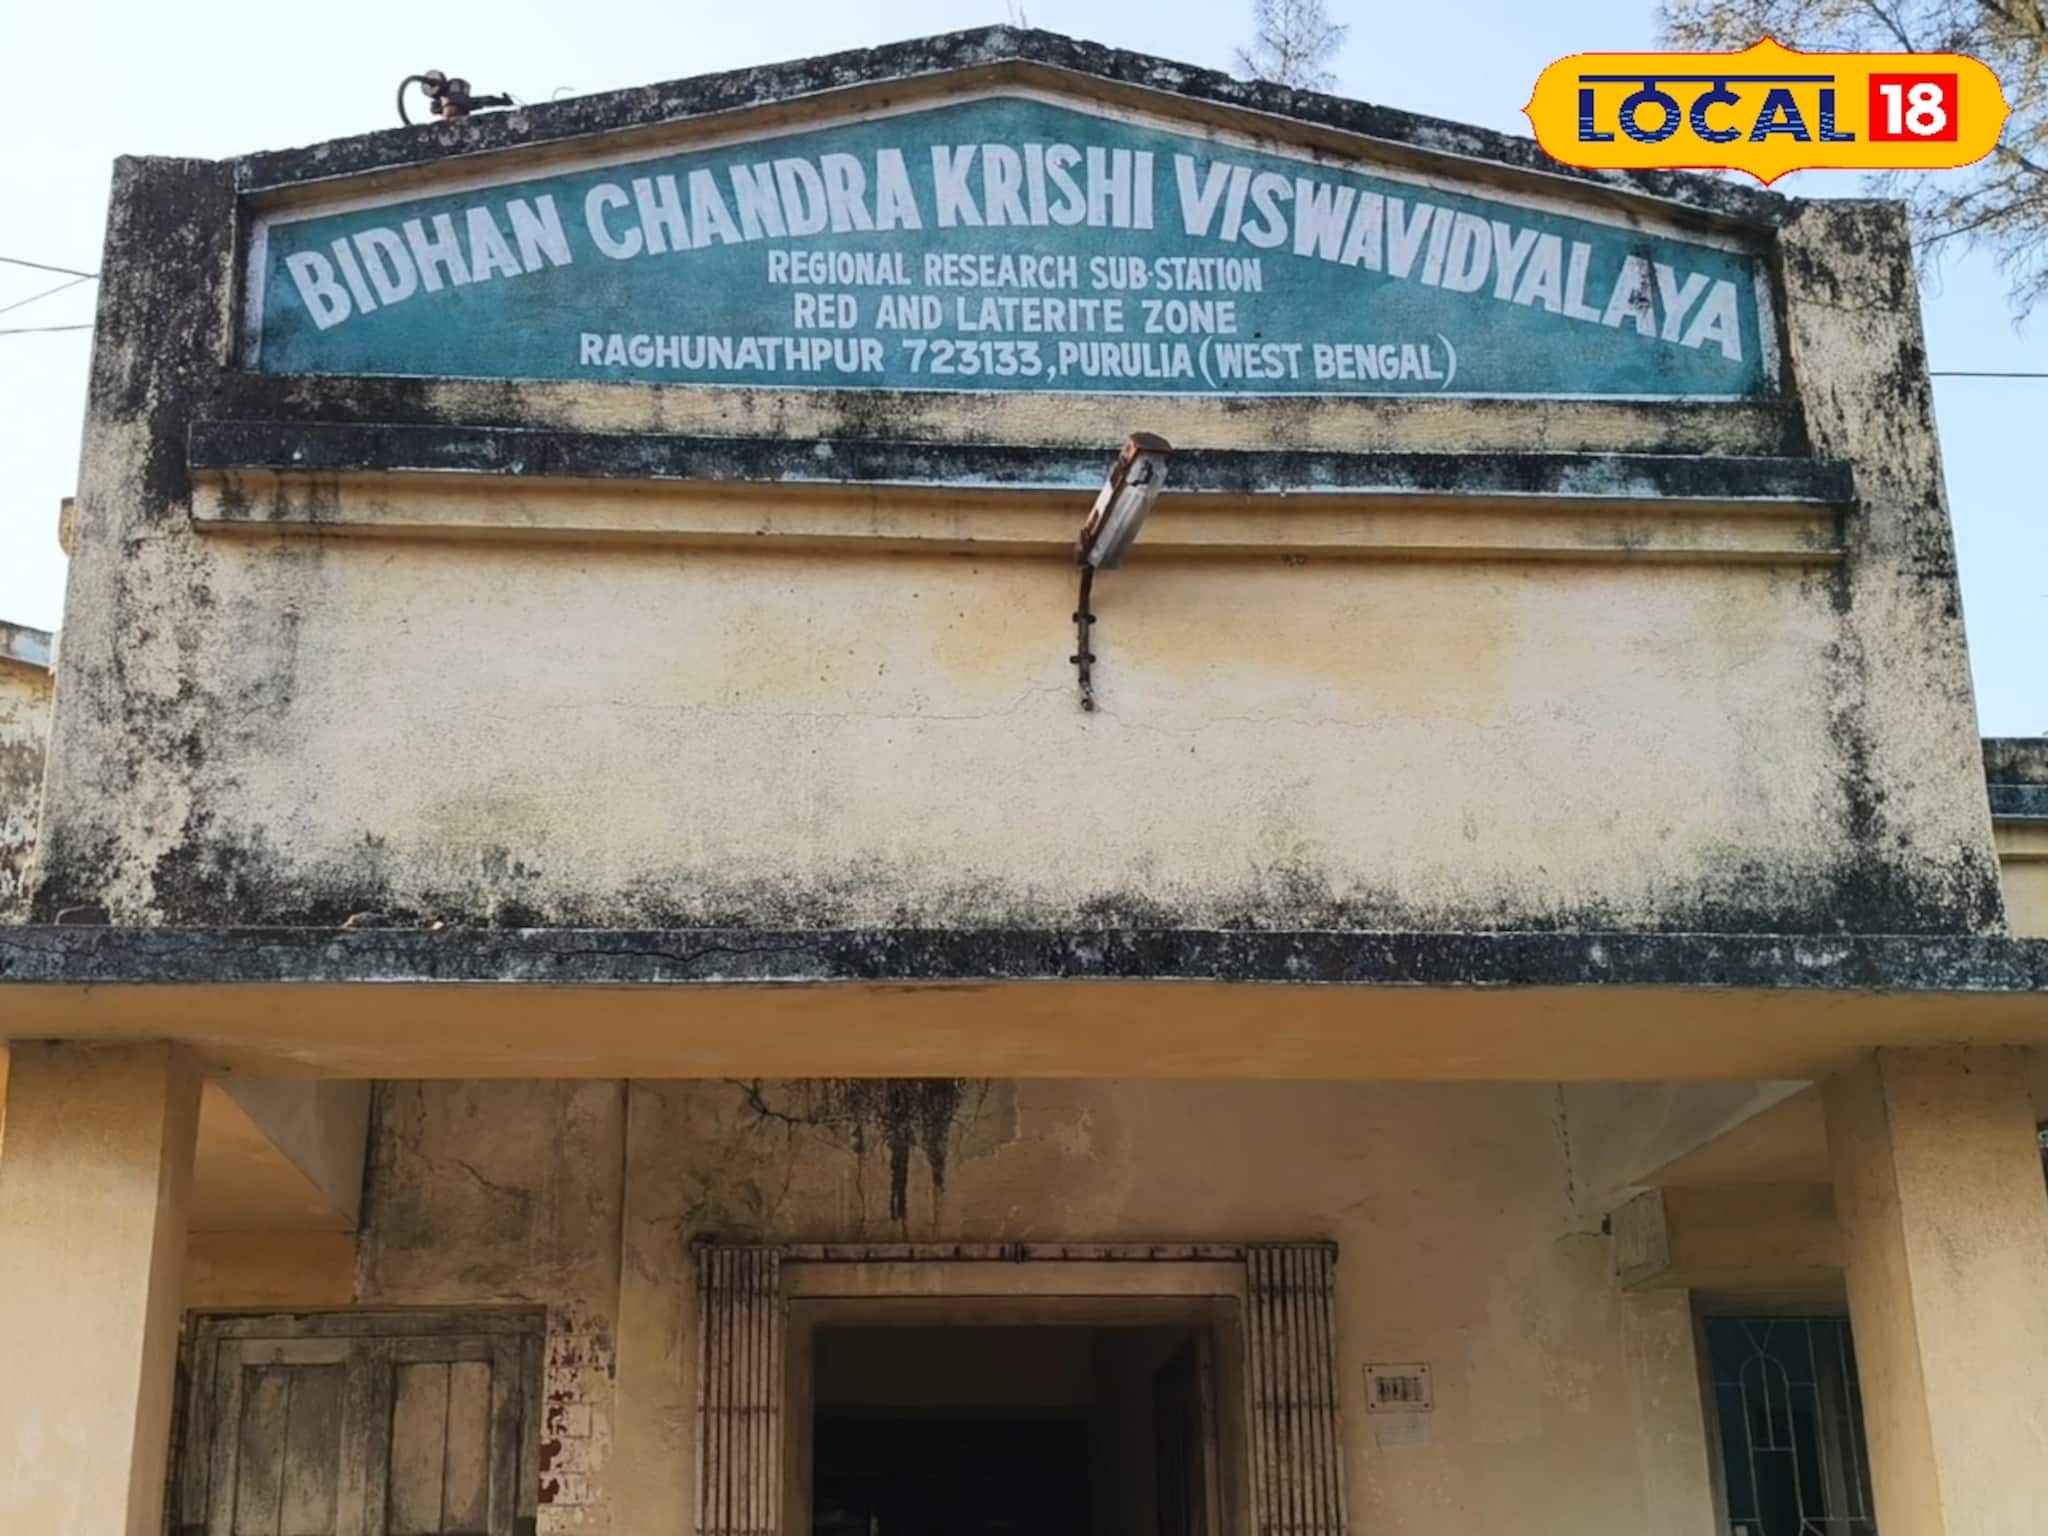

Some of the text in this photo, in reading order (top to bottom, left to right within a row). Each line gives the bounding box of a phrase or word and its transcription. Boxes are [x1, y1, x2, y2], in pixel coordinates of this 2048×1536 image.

[286, 143, 1743, 362] BIDHAN CHANDRA KRISHI VISWAVIDYALAYA
[767, 250, 911, 287] REGIONAL
[923, 253, 1079, 290] RESEARCH
[793, 292, 1238, 334] RED AND LATERITE ZONE
[579, 333, 885, 373] RAGHUNATHPUR
[1200, 335, 1303, 388] (WEST
[1313, 333, 1458, 388] BENGAL)
